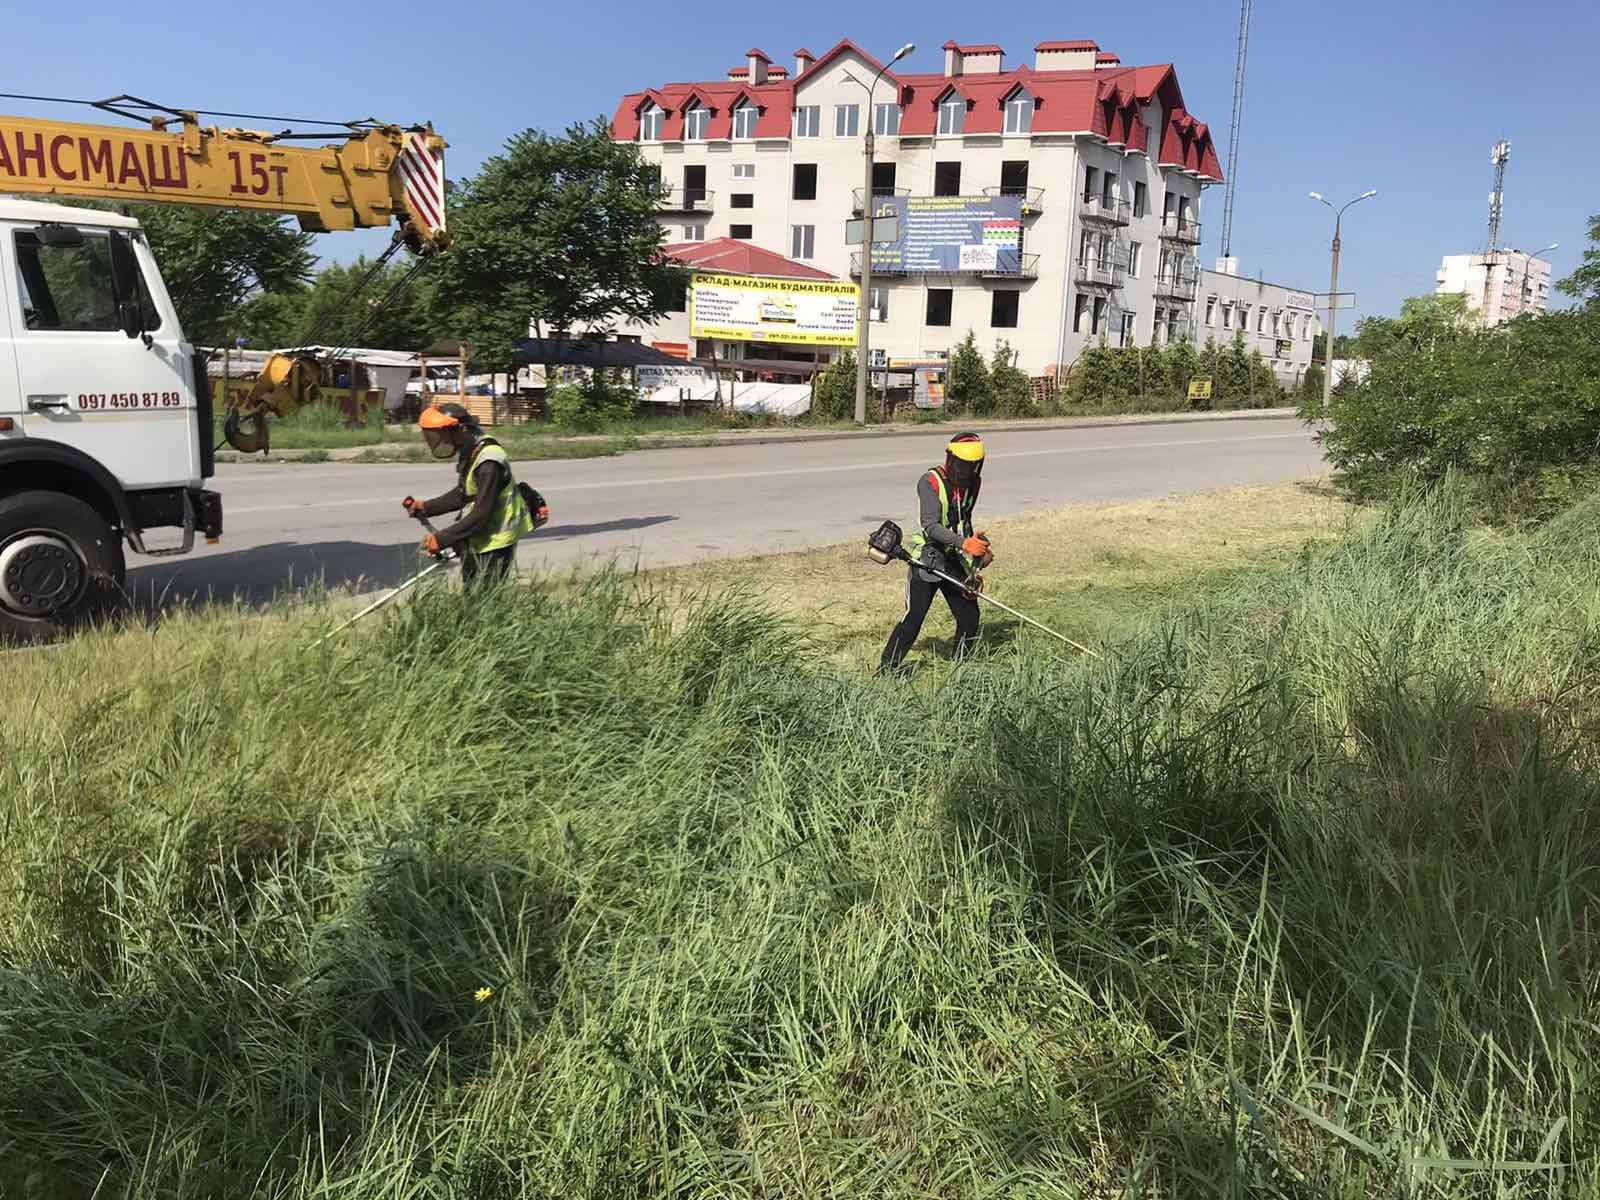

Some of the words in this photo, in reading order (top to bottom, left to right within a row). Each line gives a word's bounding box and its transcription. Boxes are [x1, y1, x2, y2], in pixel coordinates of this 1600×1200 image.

[695, 276, 778, 290] СКЛАД-МАГАЗИН
[780, 283, 856, 294] БУДМАТЕРІАЛІВ
[78, 394, 106, 409] 097
[110, 393, 138, 408] 450
[142, 392, 158, 407] 87
[162, 392, 180, 406] 89
